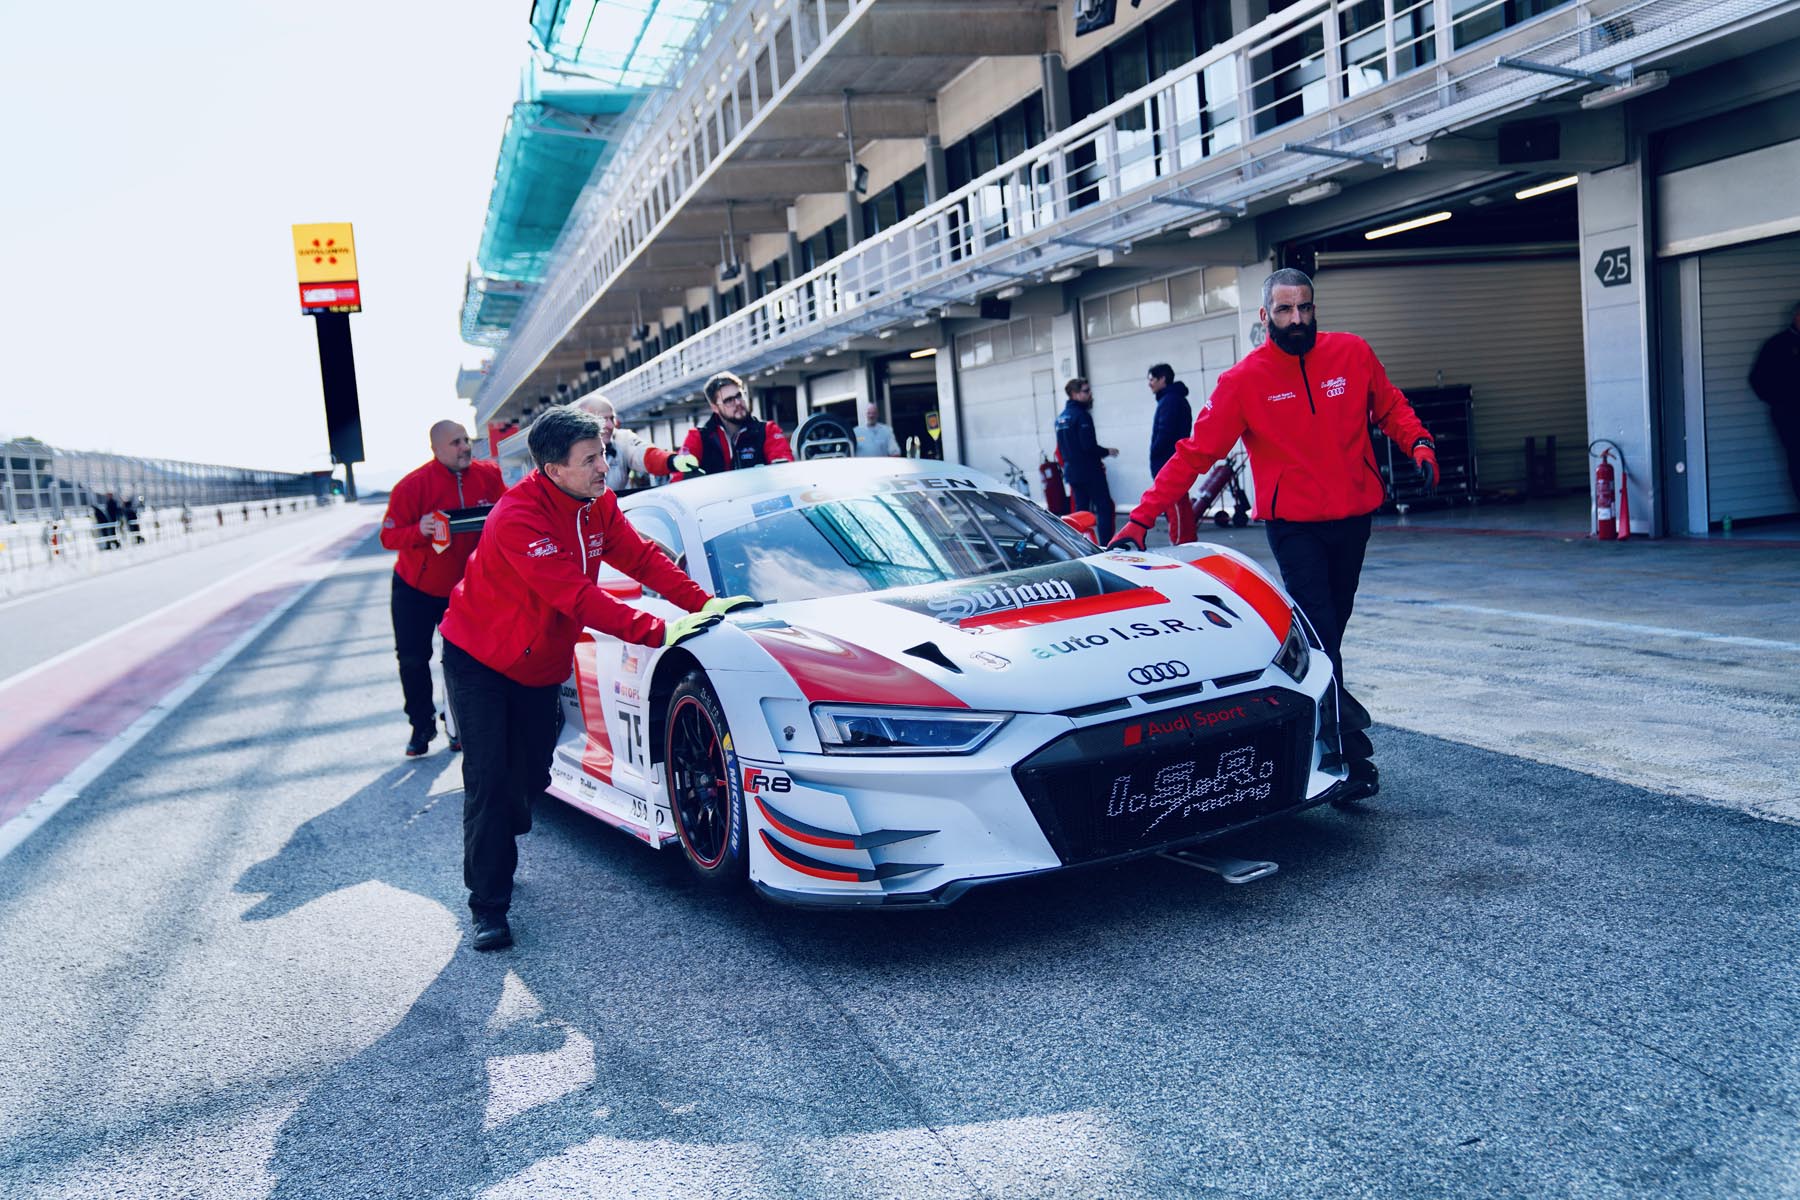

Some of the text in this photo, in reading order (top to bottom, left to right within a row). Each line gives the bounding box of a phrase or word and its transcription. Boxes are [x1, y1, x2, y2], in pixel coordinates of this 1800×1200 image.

[1603, 253, 1628, 281] 25
[1031, 618, 1204, 660] auto I.S.R.
[1149, 706, 1247, 736] Audi Sport
[752, 775, 791, 793] R8
[729, 767, 740, 850] MICHELIN
